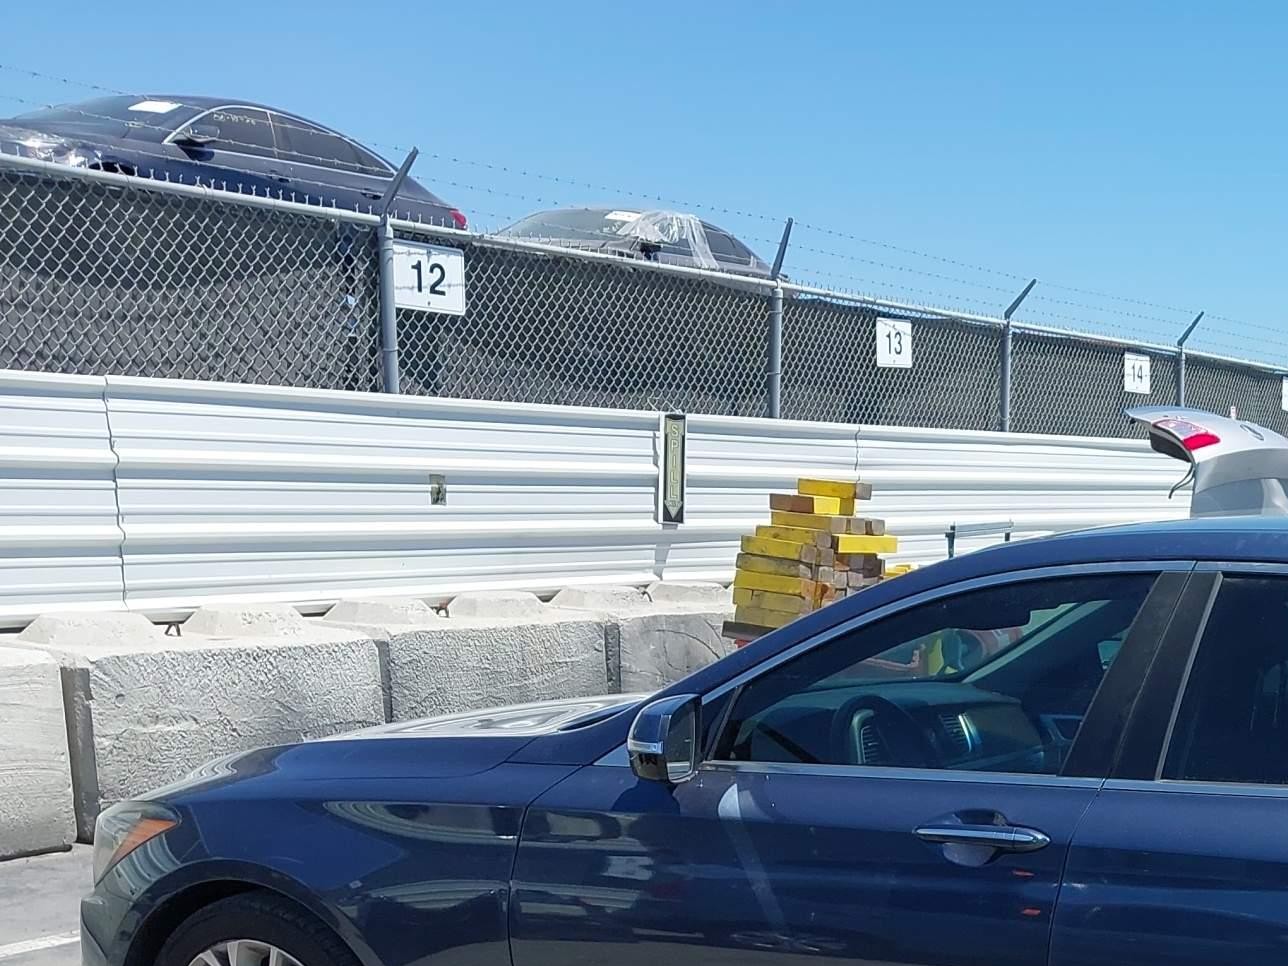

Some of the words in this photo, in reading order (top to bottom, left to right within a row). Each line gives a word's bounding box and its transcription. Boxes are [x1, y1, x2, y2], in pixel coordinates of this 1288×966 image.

[411, 260, 446, 296] 12
[885, 331, 903, 355] 13
[1131, 362, 1143, 384] 14
[669, 424, 680, 499] SPILL
